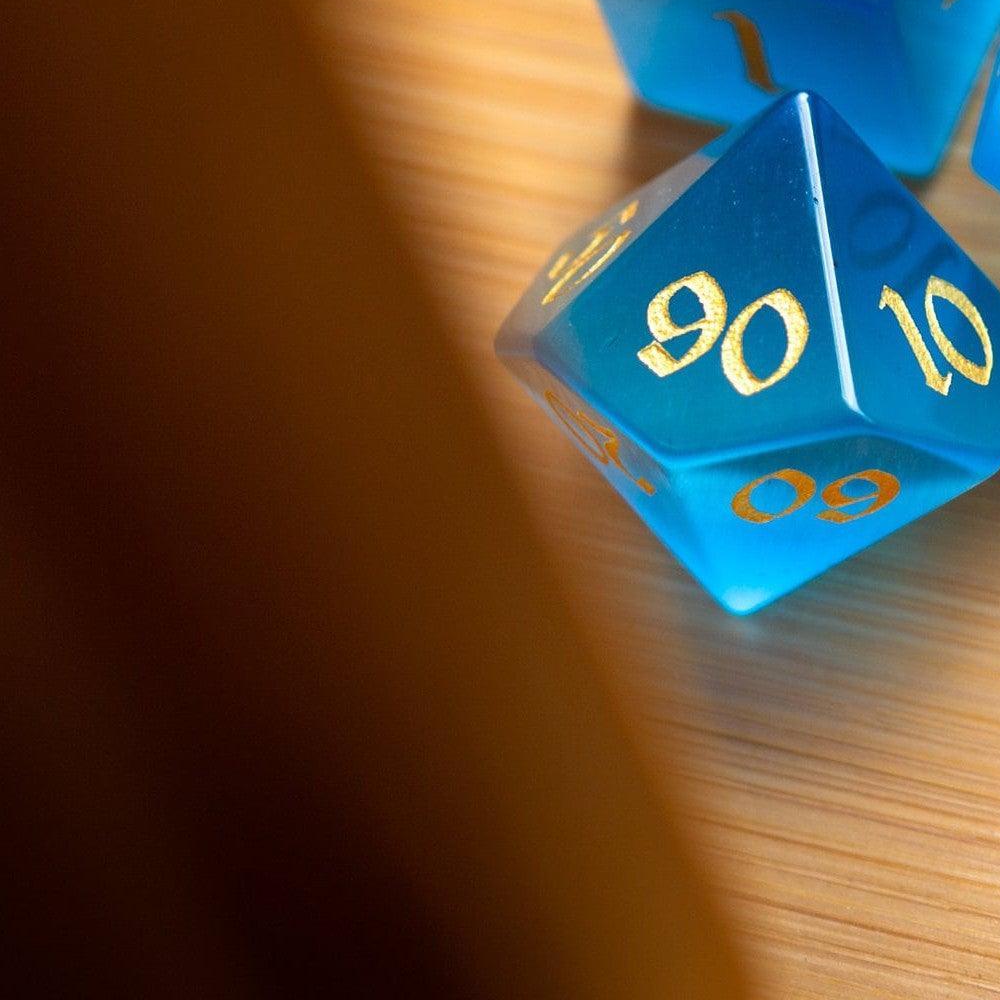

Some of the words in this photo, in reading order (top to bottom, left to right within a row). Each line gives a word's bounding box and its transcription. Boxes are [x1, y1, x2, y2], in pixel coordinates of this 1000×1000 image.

[712, 9, 778, 95] 1
[636, 270, 811, 397] 90
[877, 275, 994, 397] 10
